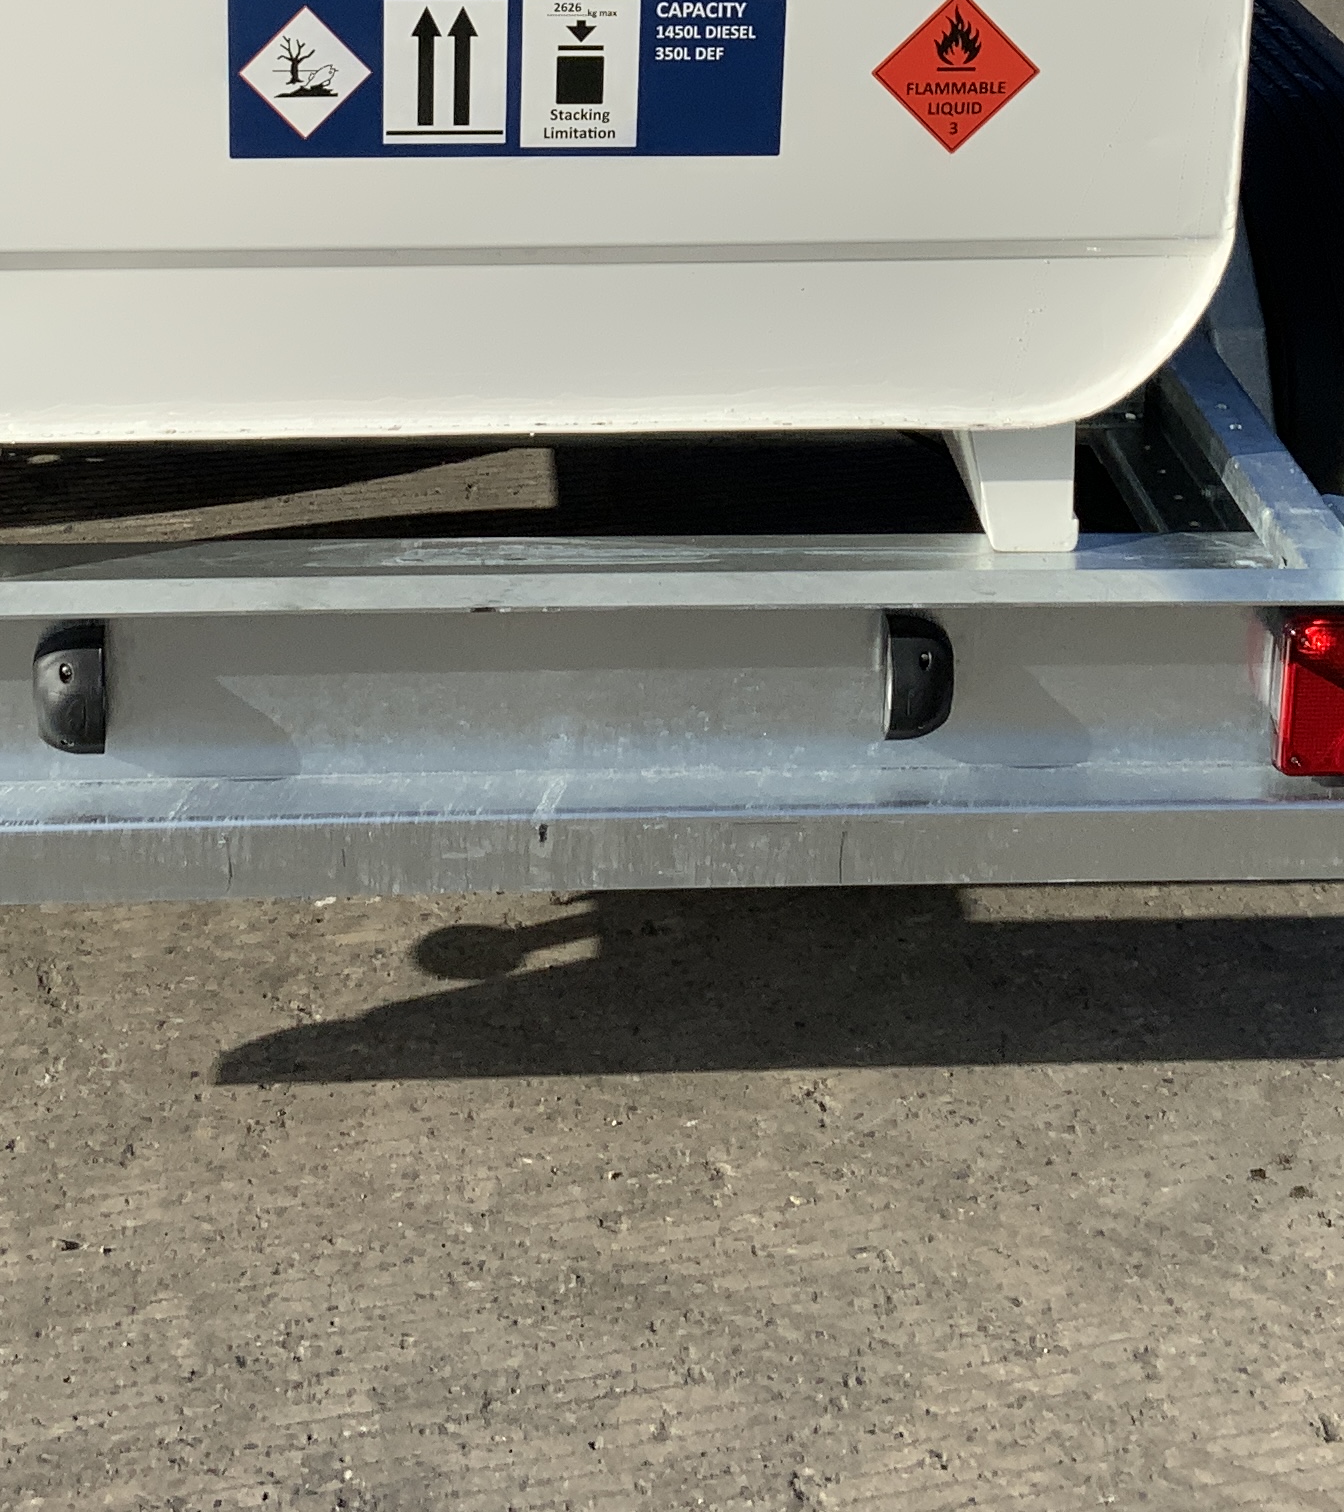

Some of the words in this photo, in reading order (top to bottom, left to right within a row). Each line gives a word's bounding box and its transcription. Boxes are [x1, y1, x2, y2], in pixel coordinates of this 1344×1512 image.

[553, 2, 582, 13] 2626
[587, 8, 597, 18] kg
[599, 10, 618, 18] max
[656, 1, 747, 18] CAPACITY
[656, 25, 702, 39] 1450L
[705, 26, 756, 39] DIESEL
[655, 47, 692, 61] 350L
[695, 47, 725, 60] DEF
[906, 81, 1007, 96] FLAMMABLE
[550, 108, 611, 124] Stacking
[927, 101, 983, 117] LIQUID
[543, 126, 616, 140] Limitation
[948, 121, 959, 135] 3
